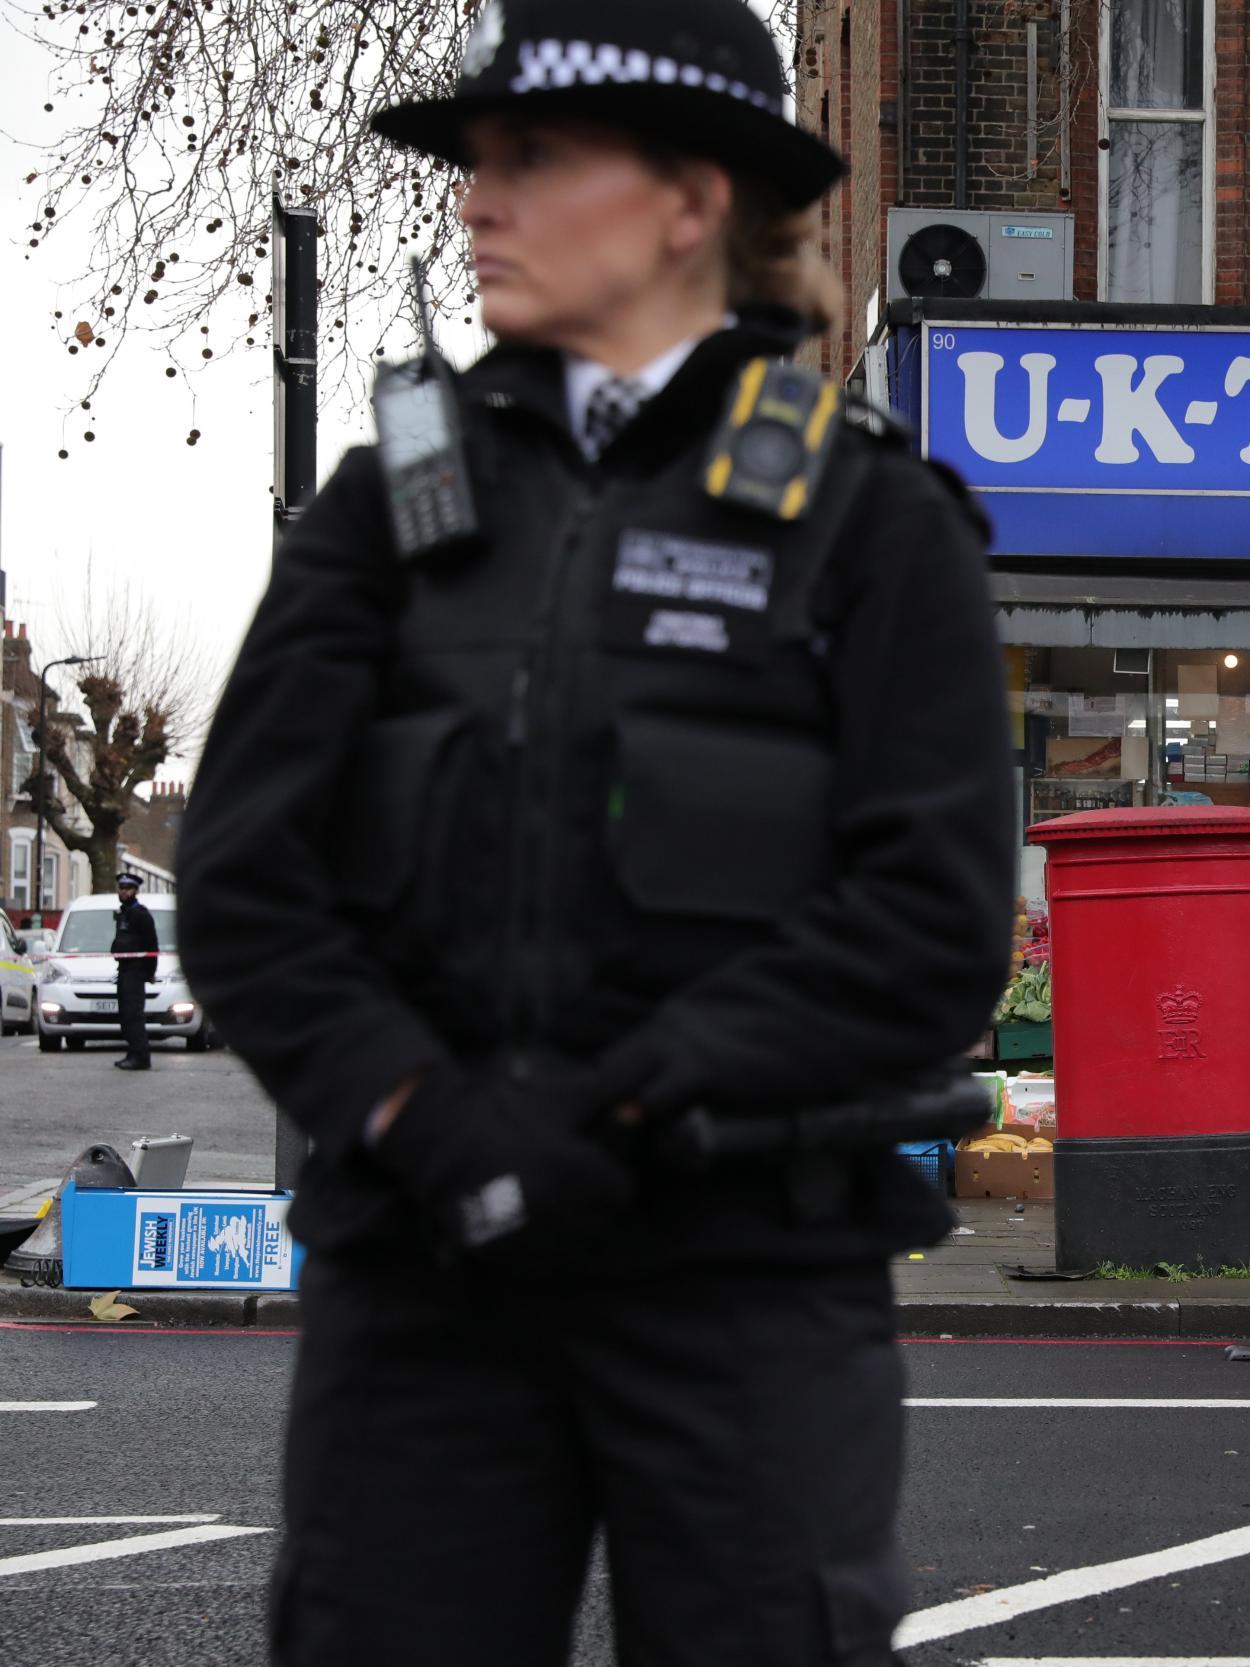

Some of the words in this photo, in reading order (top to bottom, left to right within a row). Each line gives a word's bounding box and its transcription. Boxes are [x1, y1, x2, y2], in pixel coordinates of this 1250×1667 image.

[933, 333, 955, 349] 90
[139, 1220, 157, 1269] JEWISH
[154, 1215, 168, 1268] WEEKLY
[264, 1221, 280, 1265] FREE
